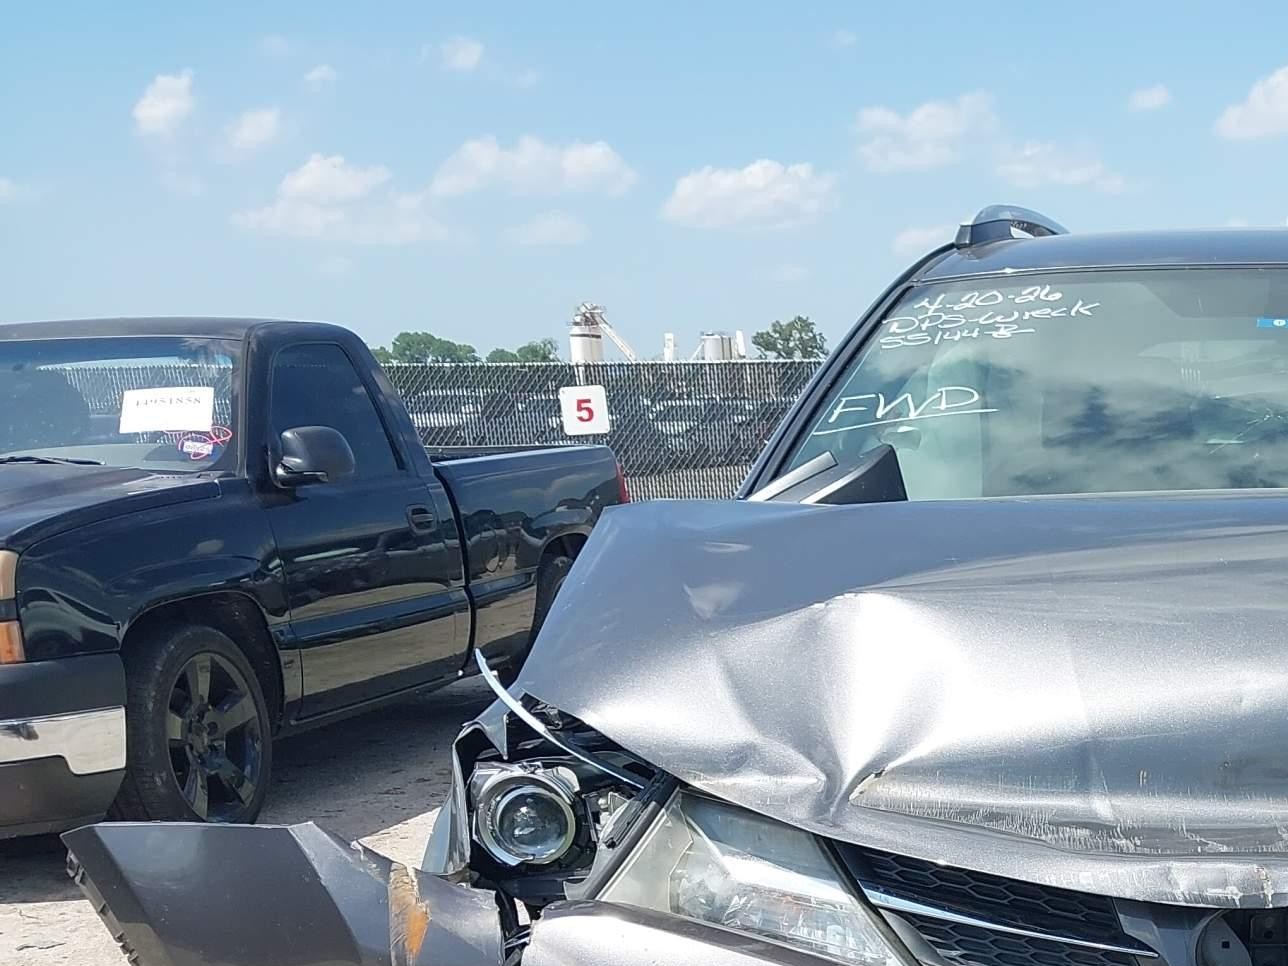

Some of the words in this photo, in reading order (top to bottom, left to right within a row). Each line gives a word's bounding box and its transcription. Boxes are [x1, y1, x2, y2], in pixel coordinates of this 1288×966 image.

[913, 285, 1063, 316] 4-20-26
[576, 398, 594, 422] 5
[828, 386, 980, 423] FWD
